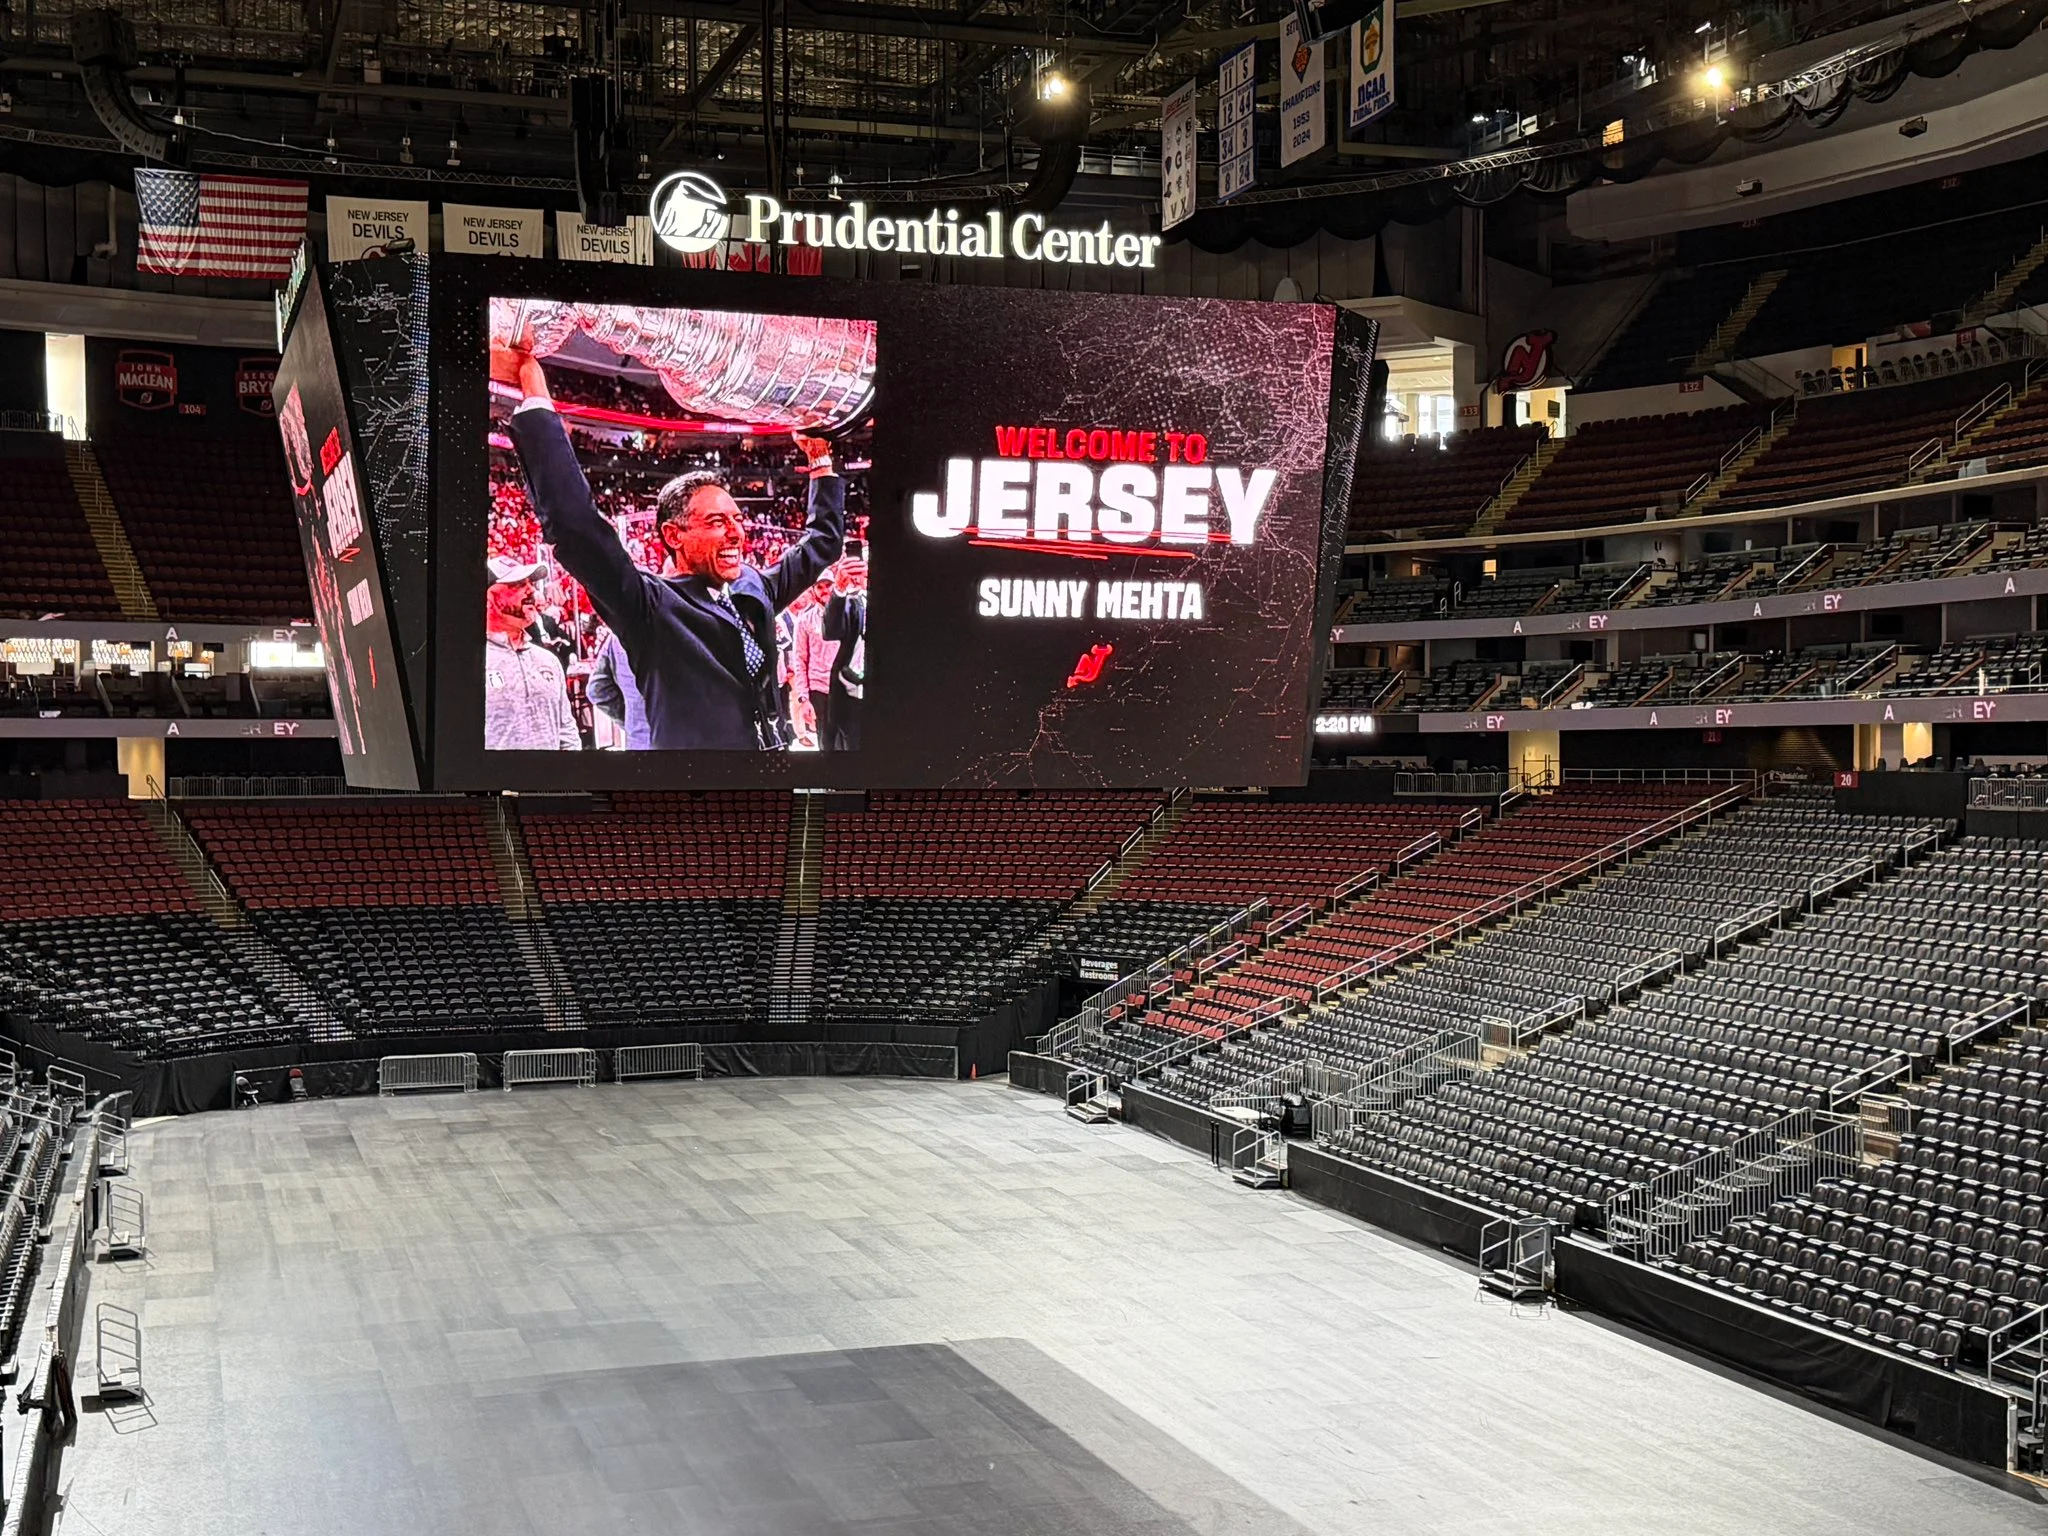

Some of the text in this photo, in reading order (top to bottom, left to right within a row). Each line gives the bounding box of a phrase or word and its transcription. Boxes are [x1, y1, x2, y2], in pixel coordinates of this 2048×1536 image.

[1224, 69, 1232, 91] 11
[1282, 80, 1321, 113] CHAMPIONS
[1358, 73, 1386, 107] NCAA
[1223, 103, 1232, 126] 12
[1222, 136, 1233, 160] 34
[347, 209, 409, 222] NEW JERSEY
[463, 216, 523, 230] NEW JERSEY
[352, 223, 405, 240] DEVILS
[468, 230, 519, 247] DEVILS
[577, 224, 635, 237] NEW JERSEY
[744, 194, 1161, 268] Prudential Center
[581, 237, 630, 254] DEVILS
[131, 363, 161, 373] JOHN
[119, 372, 173, 390] MACLEAN
[1684, 381, 1699, 392] 132
[185, 404, 201, 414] 104
[1463, 407, 1478, 416] 133
[995, 425, 1208, 463] WELCOME TO
[912, 457, 1277, 545] JERSEY
[2004, 577, 2016, 594] A
[978, 578, 1203, 620] SUNNY MEHTA
[1753, 603, 1762, 617] A
[165, 627, 179, 640] A
[1513, 620, 1523, 634] A
[1649, 711, 1658, 726] A
[1884, 704, 1894, 721] A
[167, 722, 180, 735] A
[1350, 716, 1372, 733] PM
[1840, 774, 1852, 786] 20
[1080, 958, 1118, 970] Beverages
[1080, 970, 1119, 981] Restrooms
